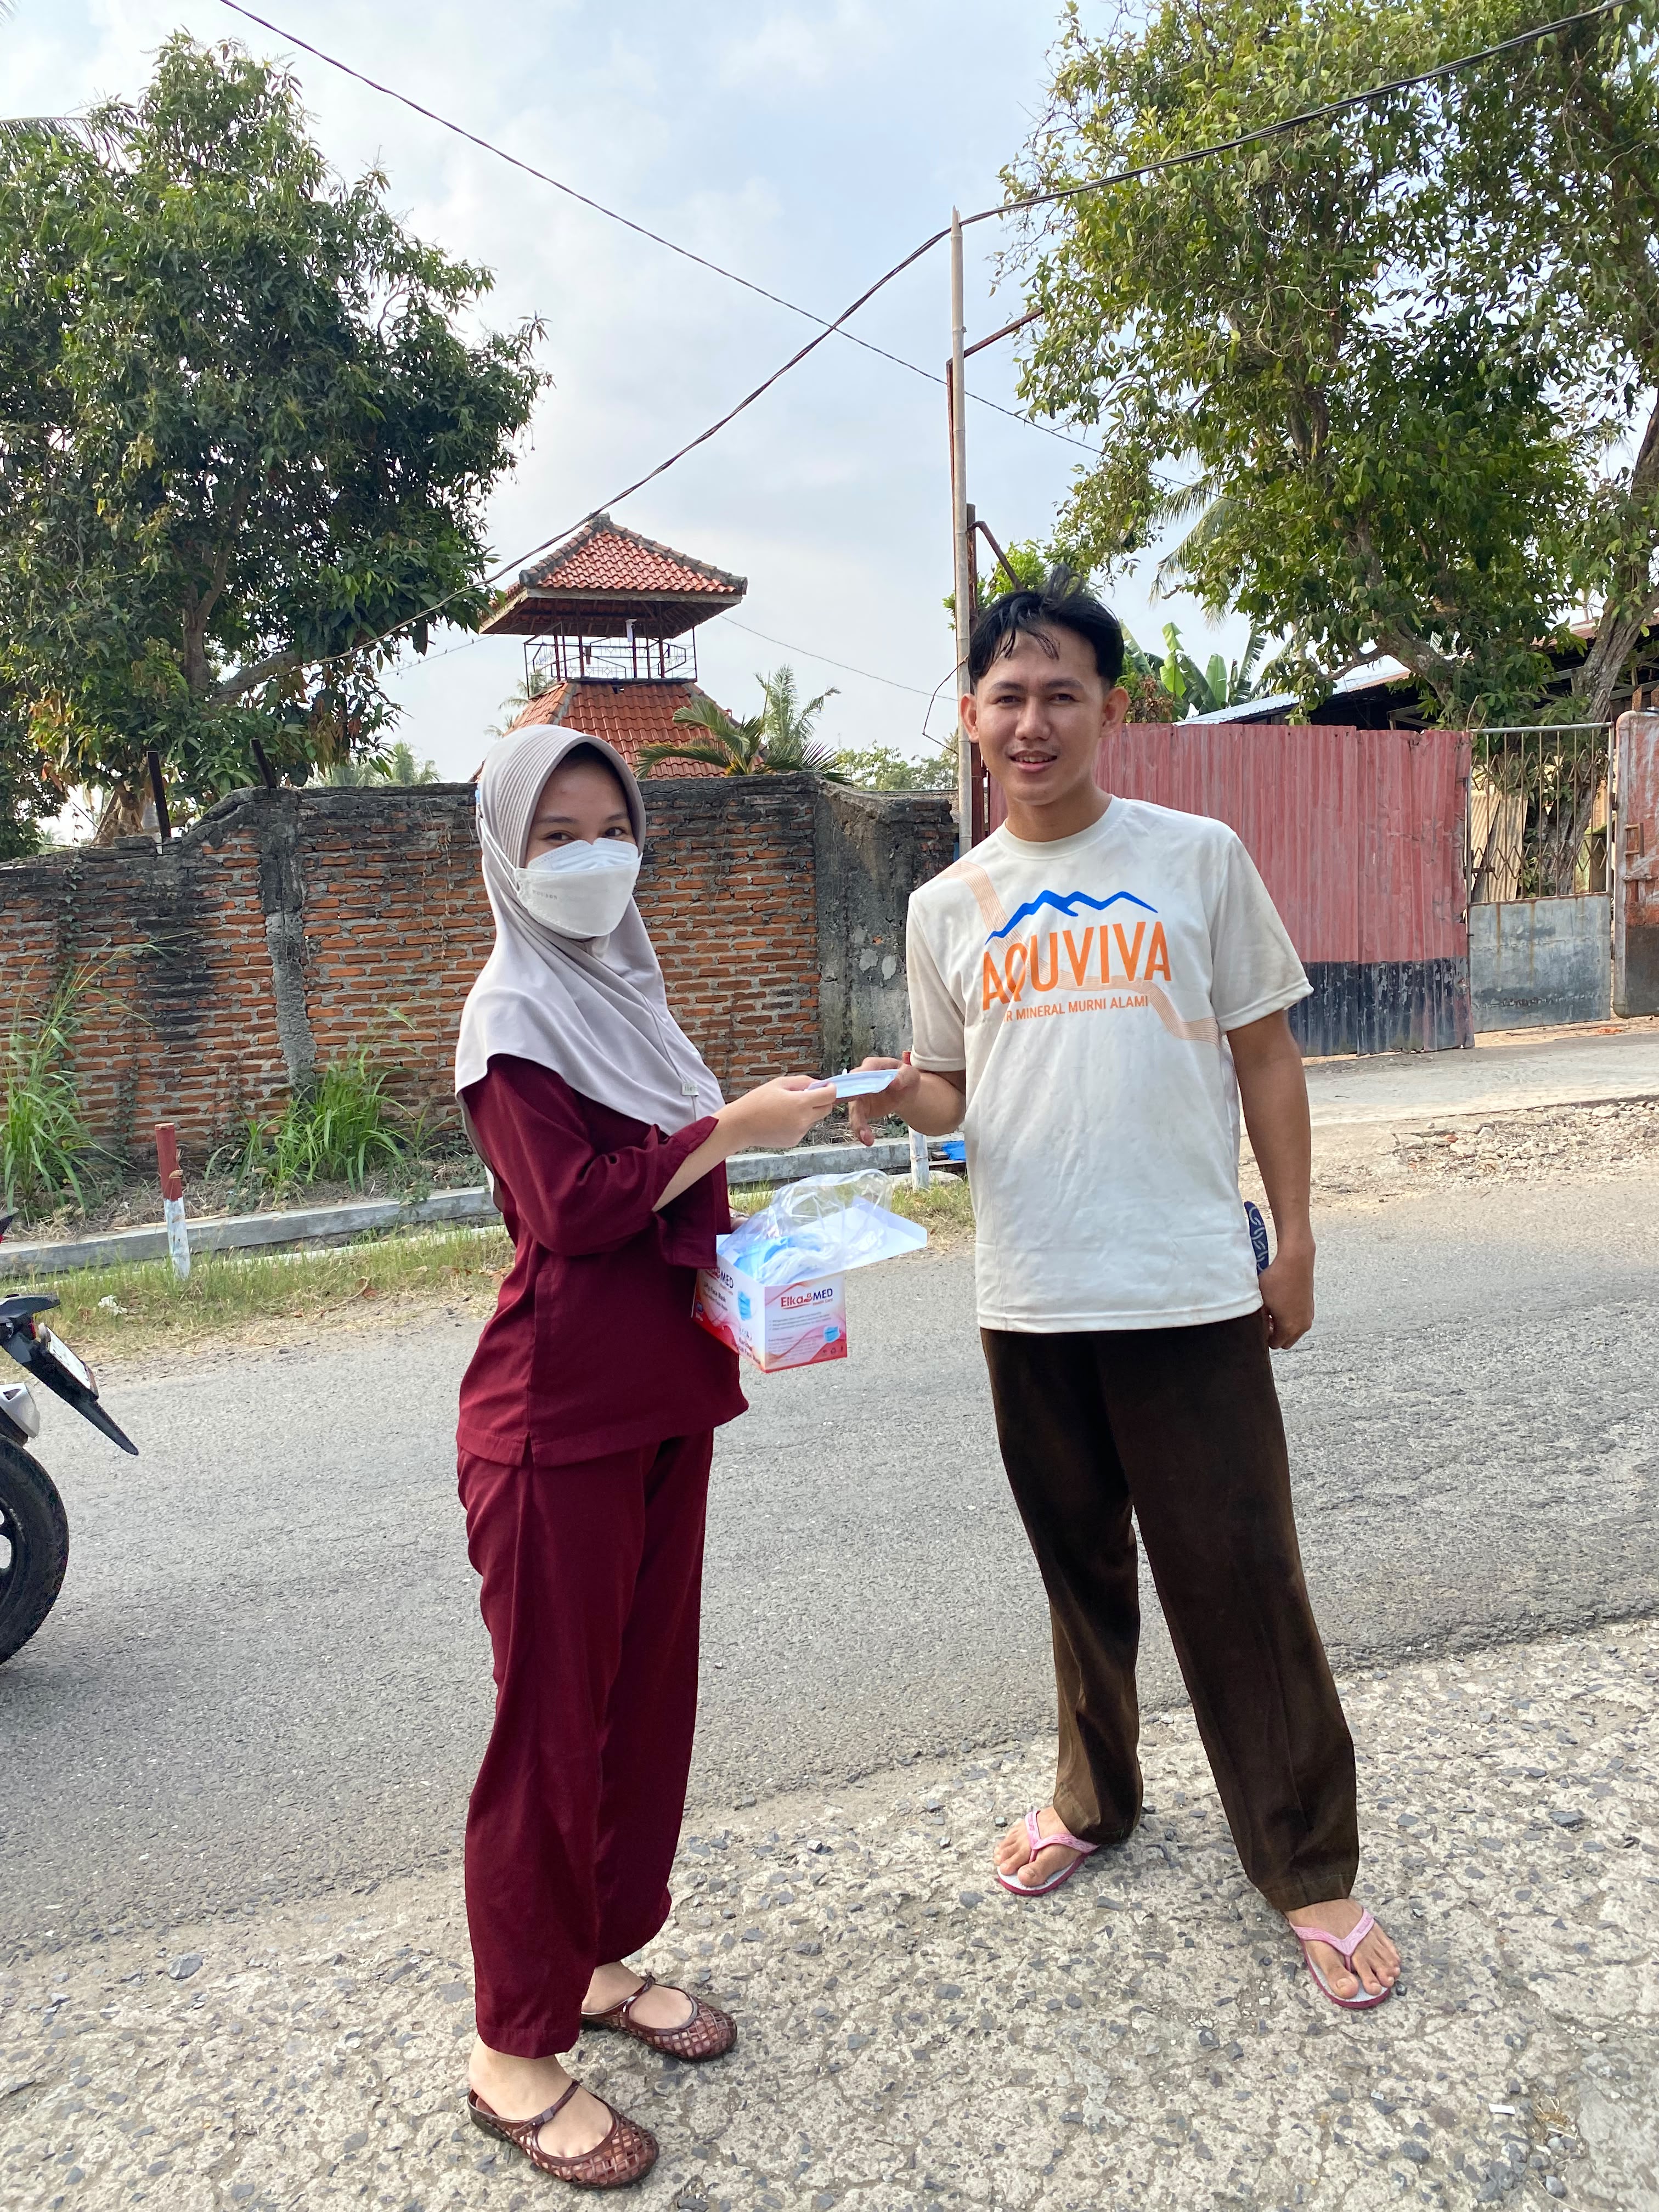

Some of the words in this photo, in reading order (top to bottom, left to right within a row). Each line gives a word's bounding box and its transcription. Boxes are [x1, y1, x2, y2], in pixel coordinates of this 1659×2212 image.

[983, 921, 1171, 1011] AQUVIVA
[1016, 1003, 1065, 1020] MINERAL
[1068, 998, 1107, 1013] MURNI
[1110, 995, 1148, 1009] ALAMI
